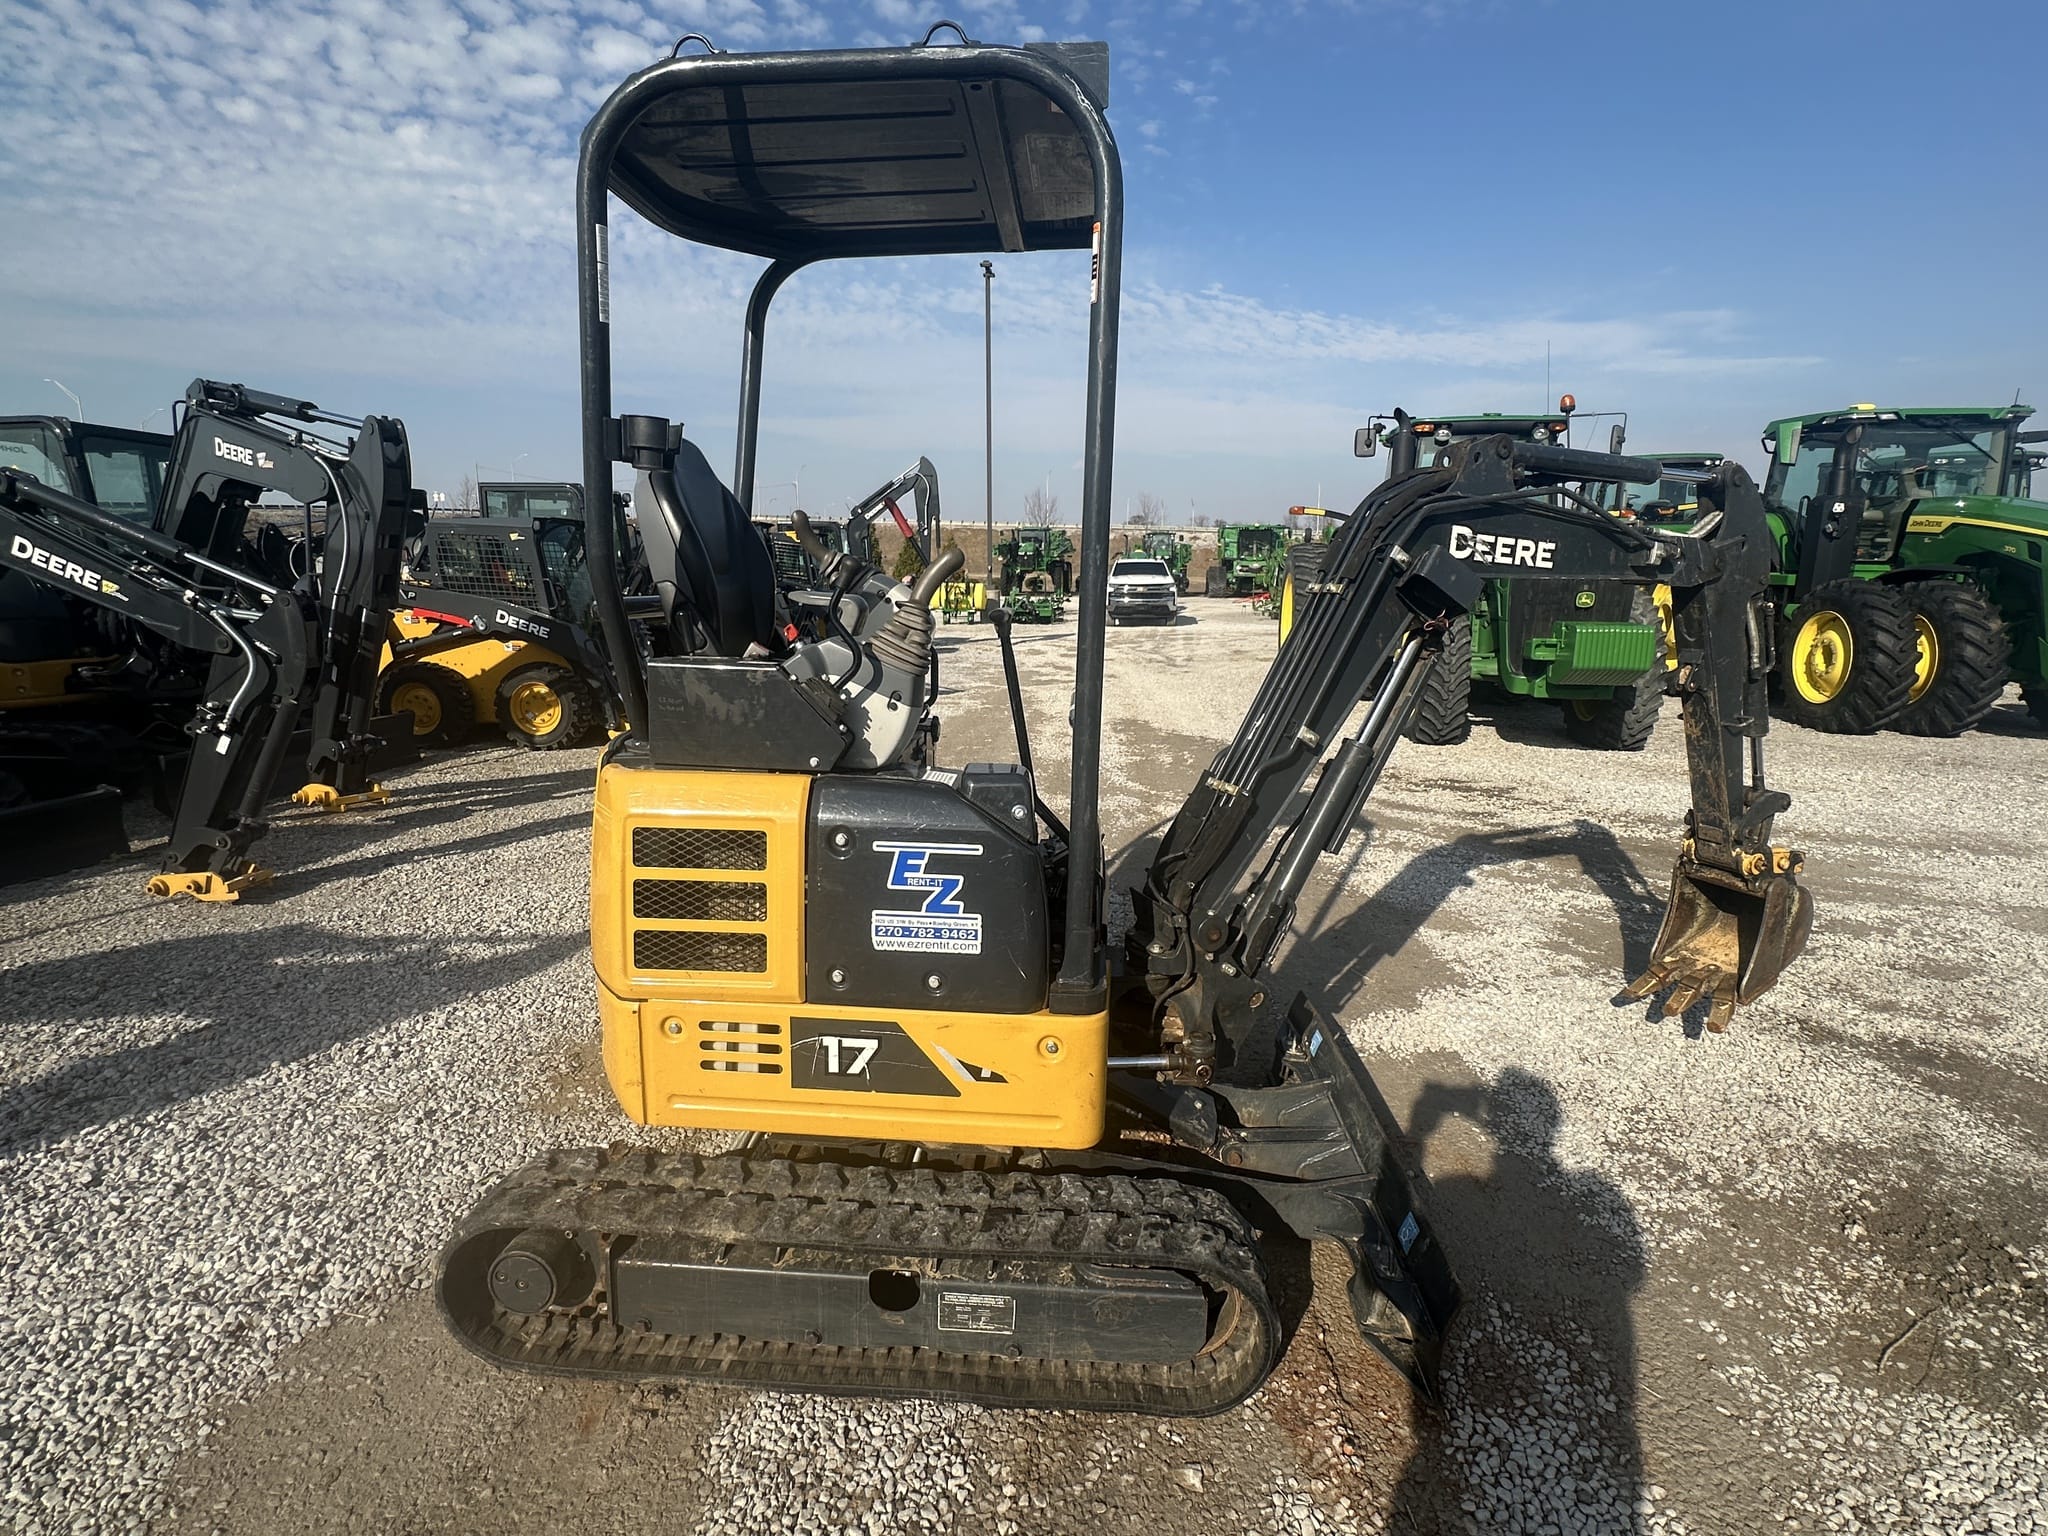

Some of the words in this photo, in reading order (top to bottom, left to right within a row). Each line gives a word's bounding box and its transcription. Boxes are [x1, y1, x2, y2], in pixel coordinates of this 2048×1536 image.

[214, 436, 254, 466] DEERE
[1449, 524, 1556, 569] DEERE
[10, 535, 101, 592] DEERE
[495, 609, 550, 639] DEERE
[907, 878, 943, 887] RENT-IT
[875, 940, 978, 951] www.ezrentit.com
[877, 926, 976, 940] 270-782-9462
[822, 1036, 879, 1074] 17
